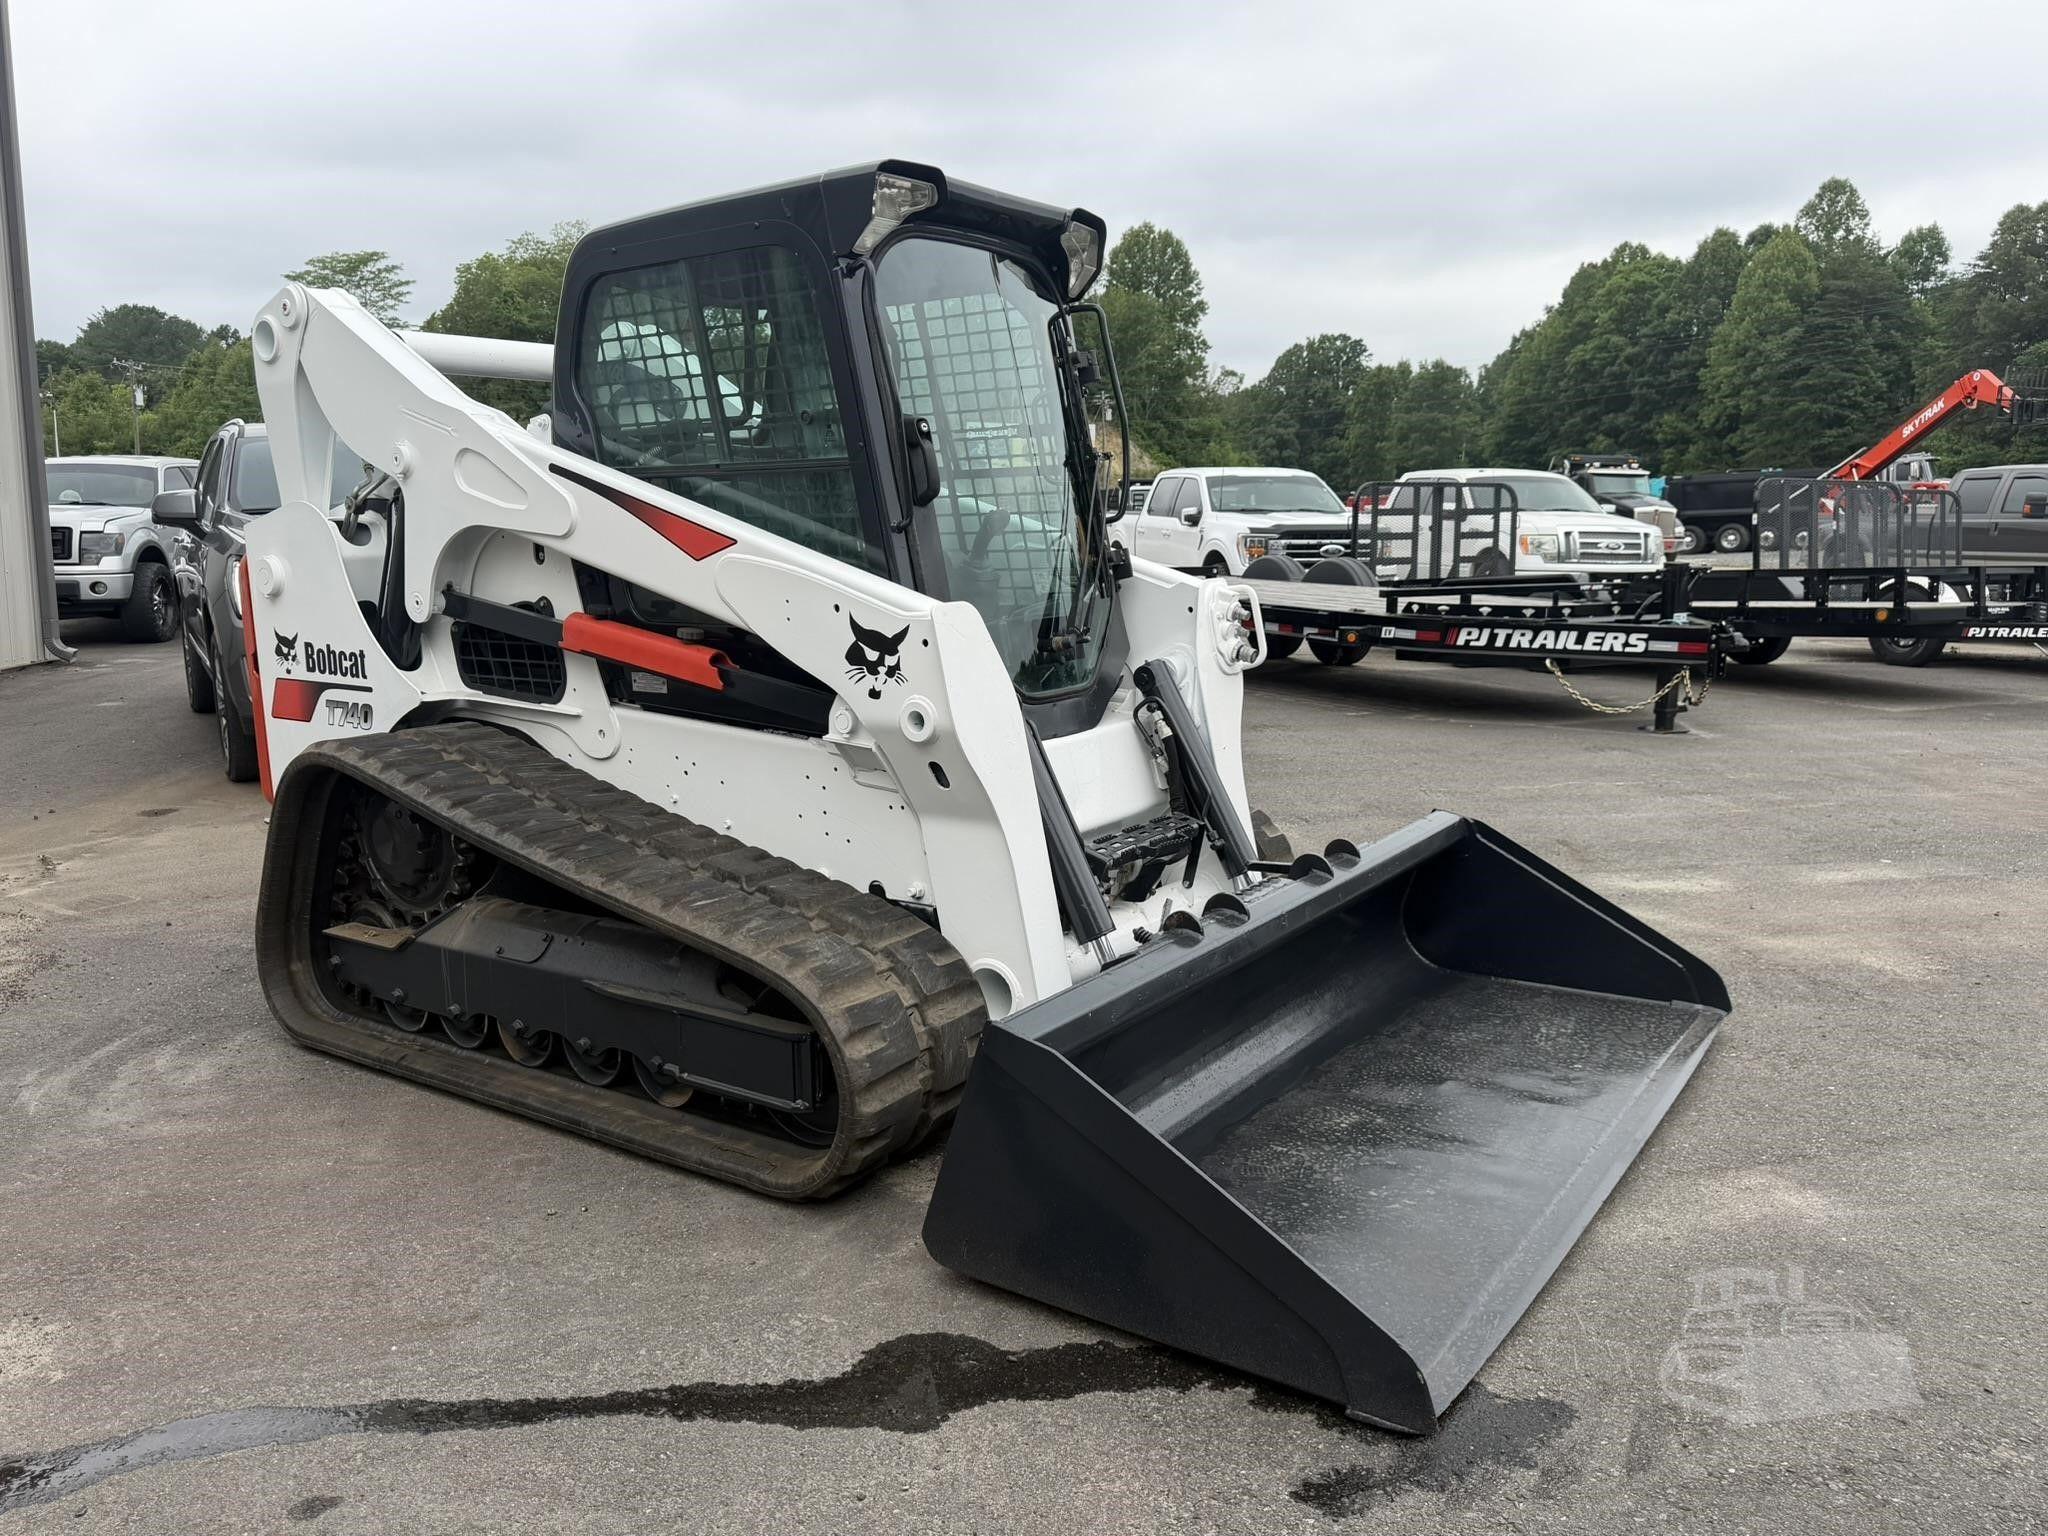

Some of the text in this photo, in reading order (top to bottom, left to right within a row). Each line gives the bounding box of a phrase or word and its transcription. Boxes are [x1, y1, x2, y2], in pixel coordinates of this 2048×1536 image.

[1902, 397, 1945, 438] SKYTRAK
[1456, 627, 1649, 653] PJ TRAILERS
[1988, 627, 2048, 638] TRAILE
[304, 641, 368, 680] Bobcat
[325, 699, 374, 731] T740
